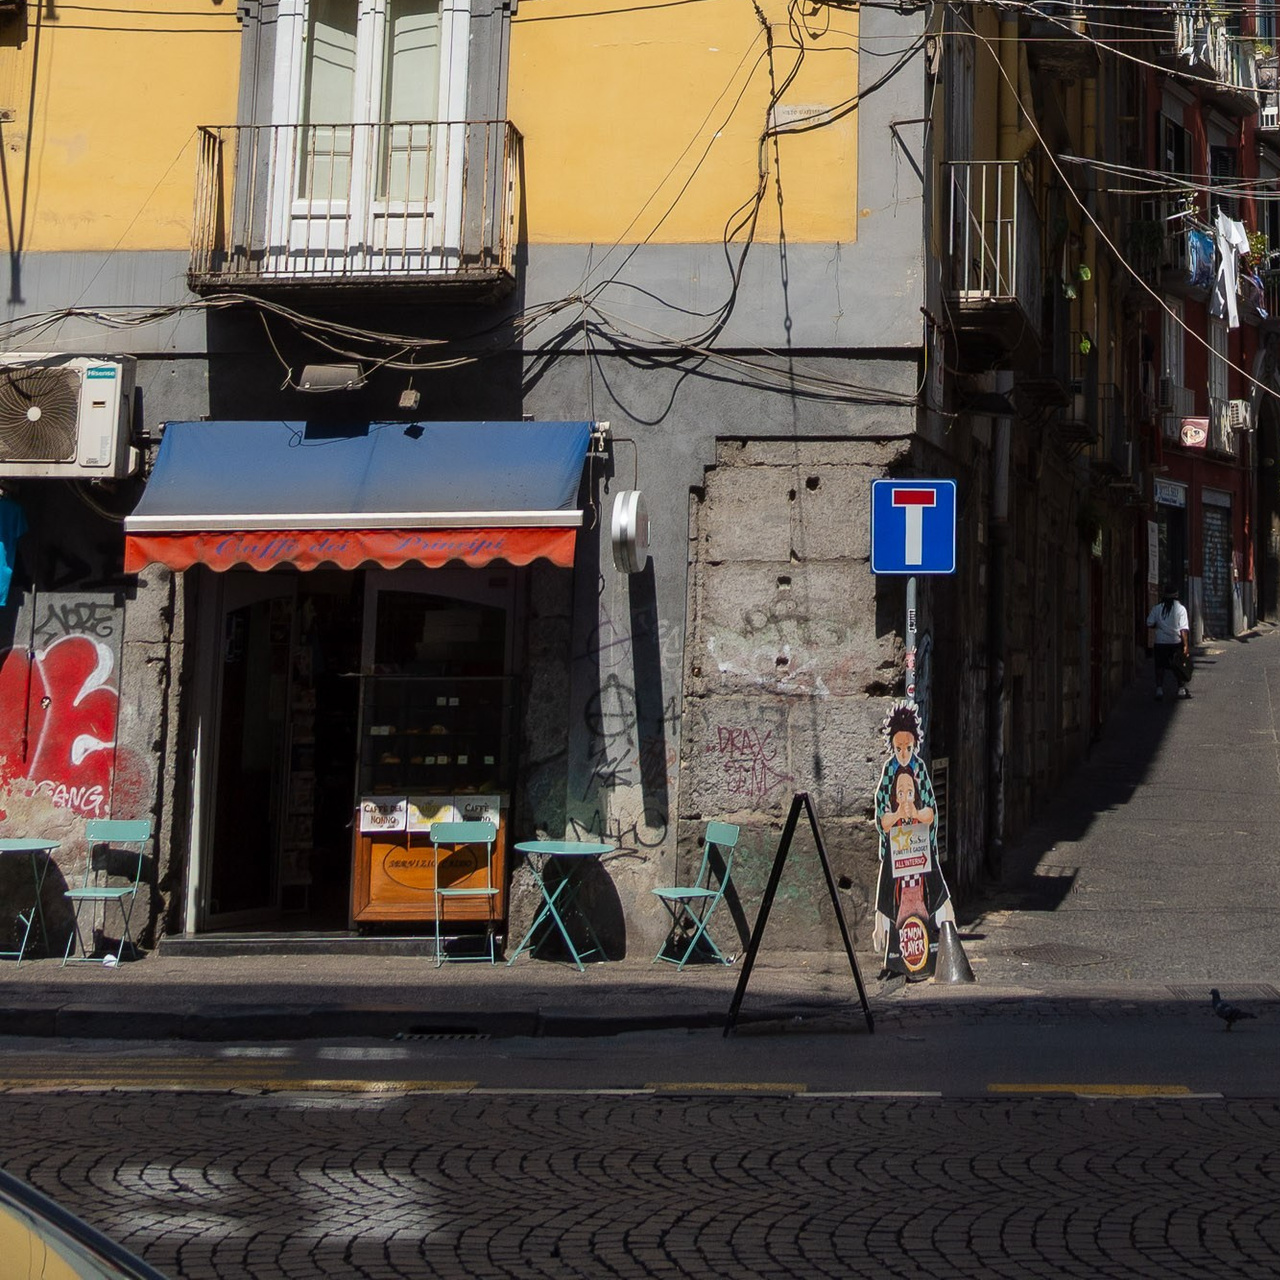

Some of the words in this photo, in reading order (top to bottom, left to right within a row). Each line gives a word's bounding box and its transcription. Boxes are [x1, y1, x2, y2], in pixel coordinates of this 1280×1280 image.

[87, 369, 116, 377] Hisense
[364, 801, 388, 813] CAFFÈ
[464, 801, 490, 813] CAFFÈ
[370, 815, 396, 825] NONNO
[899, 926, 923, 943] DEMON
[899, 939, 925, 958] SLAYER
